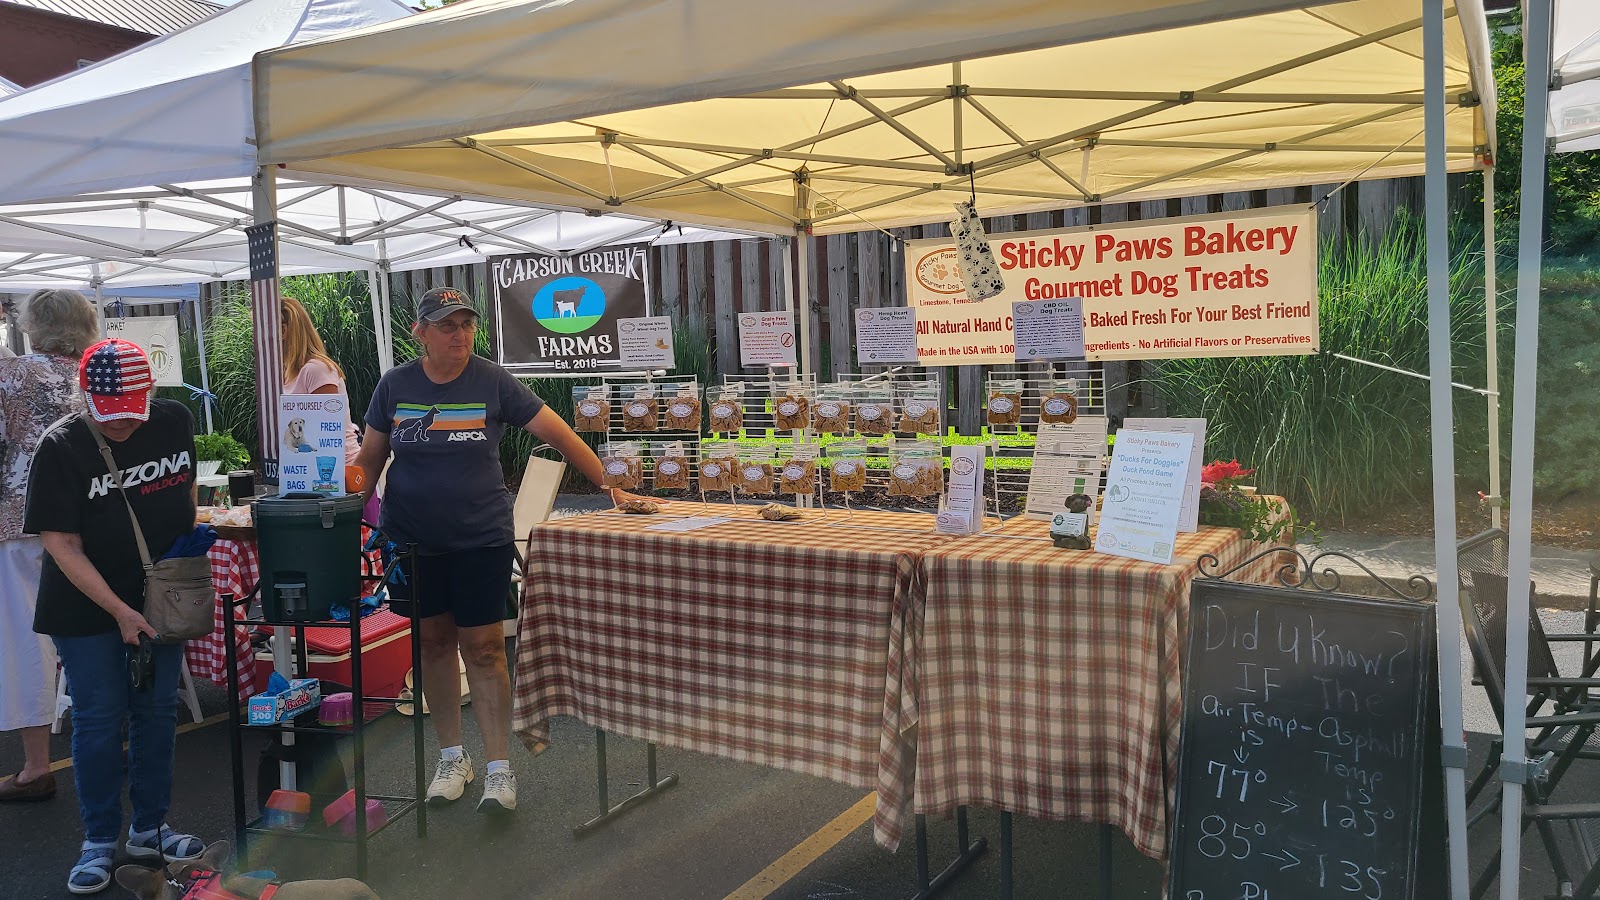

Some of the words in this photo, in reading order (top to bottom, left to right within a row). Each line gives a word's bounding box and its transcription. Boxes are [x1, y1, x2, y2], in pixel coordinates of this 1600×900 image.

[1000, 238, 1085, 271] Sticky
[1095, 235, 1172, 264] Paws
[1184, 223, 1298, 256] Bakery
[500, 256, 573, 288] CARSON
[578, 246, 641, 281] CREEK
[919, 256, 939, 273] Sticky
[920, 274, 946, 290] Gourmet
[947, 282, 959, 290] Dog
[1024, 273, 1122, 300] Gourmet
[1131, 271, 1178, 297] Dog
[1185, 264, 1269, 291] Treats
[920, 298, 951, 306] Limestone,
[917, 320, 929, 334] All
[932, 318, 971, 334] Natural
[974, 317, 1001, 333] Hand
[1090, 311, 1128, 328] Baked
[1132, 309, 1166, 326] Fresh
[1171, 307, 1192, 324] For
[1196, 306, 1228, 322] Your
[1232, 304, 1262, 320] Best
[1266, 301, 1311, 319] Friend
[537, 334, 613, 358] FARMS
[917, 348, 937, 356] Made
[940, 348, 946, 356] in
[948, 347, 960, 355] the
[963, 346, 979, 354] USA
[981, 345, 996, 354] with
[1084, 340, 1130, 352] ngredients
[1138, 339, 1150, 349] No
[1153, 337, 1192, 348] Artificial
[1195, 336, 1229, 347] Flavors
[1244, 334, 1311, 345] Preservatives
[555, 359, 571, 370] Est.
[574, 358, 597, 369] 2018
[283, 402, 294, 410] HELP
[296, 401, 322, 410] YOURSELF
[320, 422, 342, 431] FRESH
[319, 438, 342, 448] WATER
[447, 431, 487, 442] ASPCA
[1160, 440, 1180, 448] Bakery
[284, 465, 307, 474] WASTE
[287, 481, 306, 490] BAGS
[1206, 605, 1259, 652] Did
[252, 712, 271, 720] 300
[1313, 750, 1384, 793] Temp
